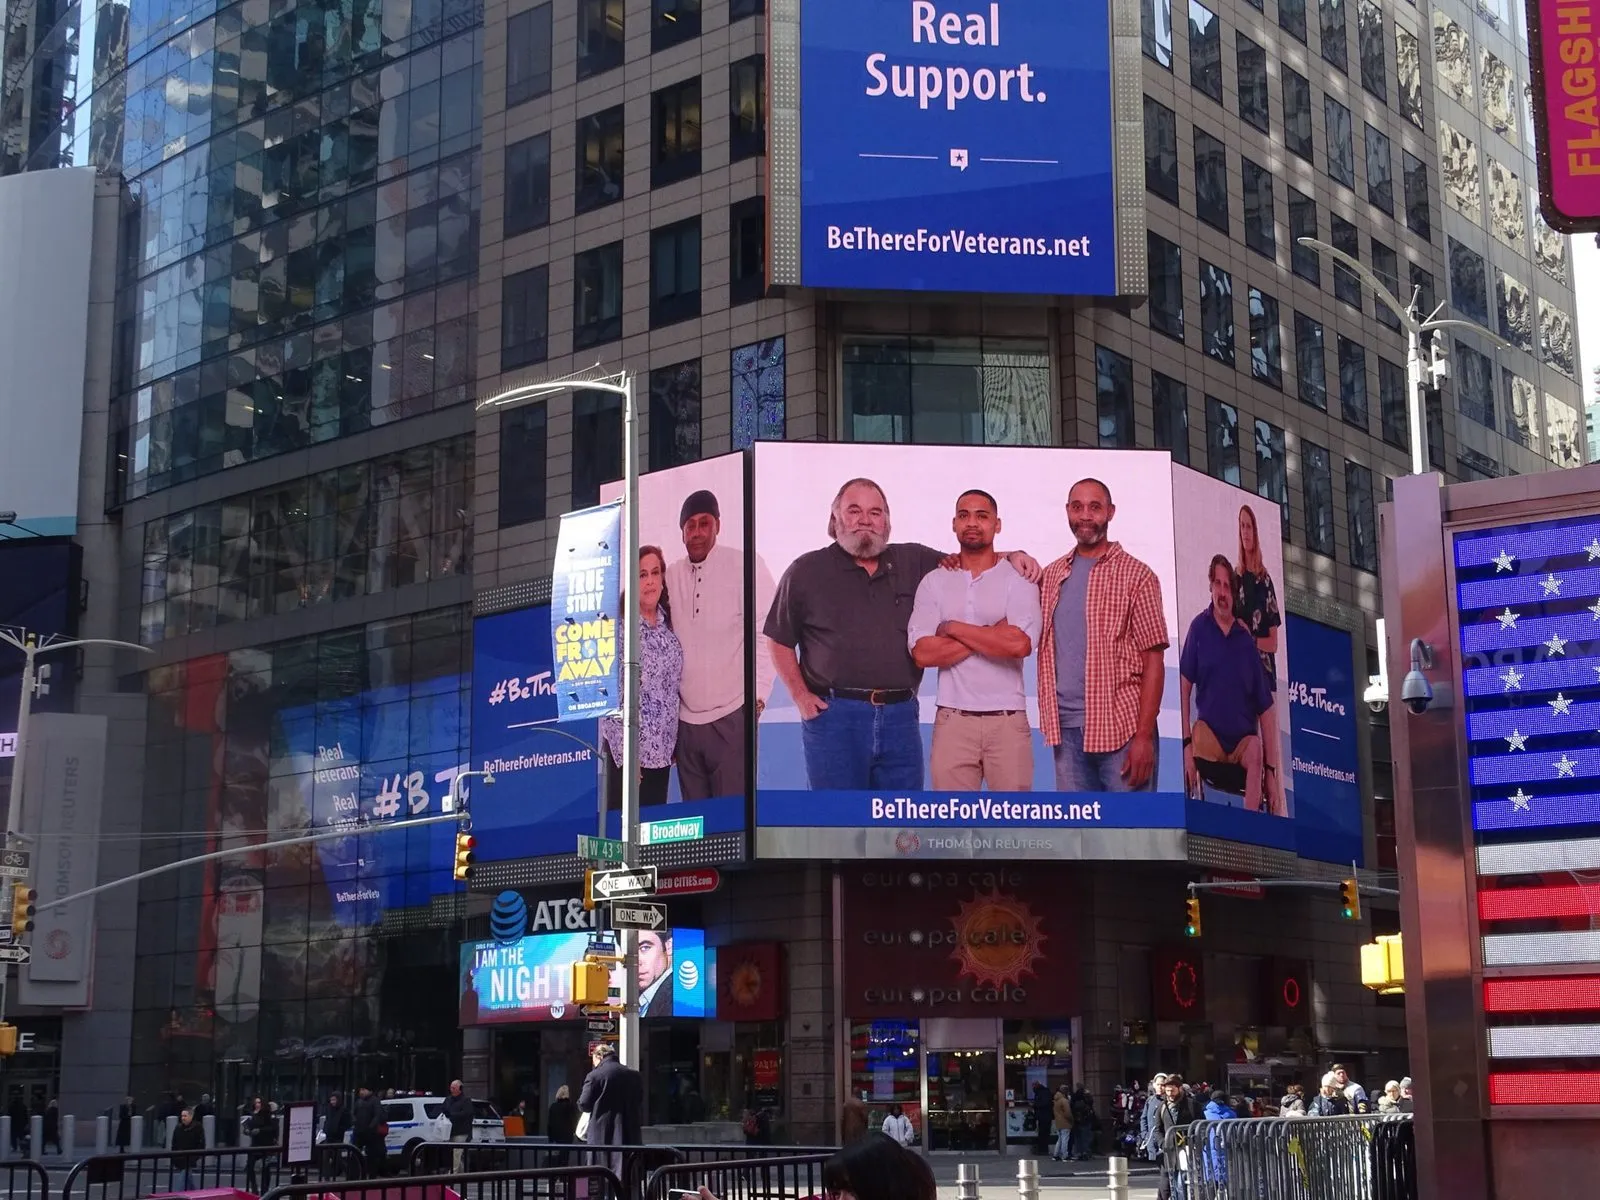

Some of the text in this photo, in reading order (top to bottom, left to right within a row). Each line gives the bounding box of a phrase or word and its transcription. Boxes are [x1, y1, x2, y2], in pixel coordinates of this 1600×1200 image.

[911, 0, 1000, 46] Real
[865, 53, 1047, 110] Support.
[1557, 0, 1600, 176] FLAGSH
[827, 226, 1091, 257] BeThereForVeterans.net
[568, 569, 604, 594] TRUE
[567, 593, 602, 613] STORY
[555, 619, 615, 643] COME
[556, 637, 615, 663] FROM
[558, 656, 615, 681] AWAY
[578, 700, 607, 710] BROADWAY
[1289, 681, 1346, 716] #BeThere
[318, 742, 344, 762] Real
[484, 748, 592, 774] BeThereForVeterans.net
[1292, 756, 1356, 785] eThereForVeterans.net
[332, 792, 359, 812] Real
[871, 798, 1101, 821] BeThereForVeterans.net
[54, 756, 80, 918] THOMSON REUTERS
[652, 822, 700, 840] Broadway
[589, 840, 599, 856] W
[602, 843, 614, 858] 43
[927, 838, 1053, 849] THOMSON REUTERS
[601, 875, 648, 891] ONE WAY
[674, 877, 712, 888] CITIES.com
[863, 870, 959, 892] europa
[620, 910, 659, 923] ONE WAY
[863, 927, 958, 948] europa
[480, 949, 498, 968] AM
[500, 947, 525, 966] THE
[491, 964, 567, 1001] NIGHT
[864, 985, 962, 1006] europa
